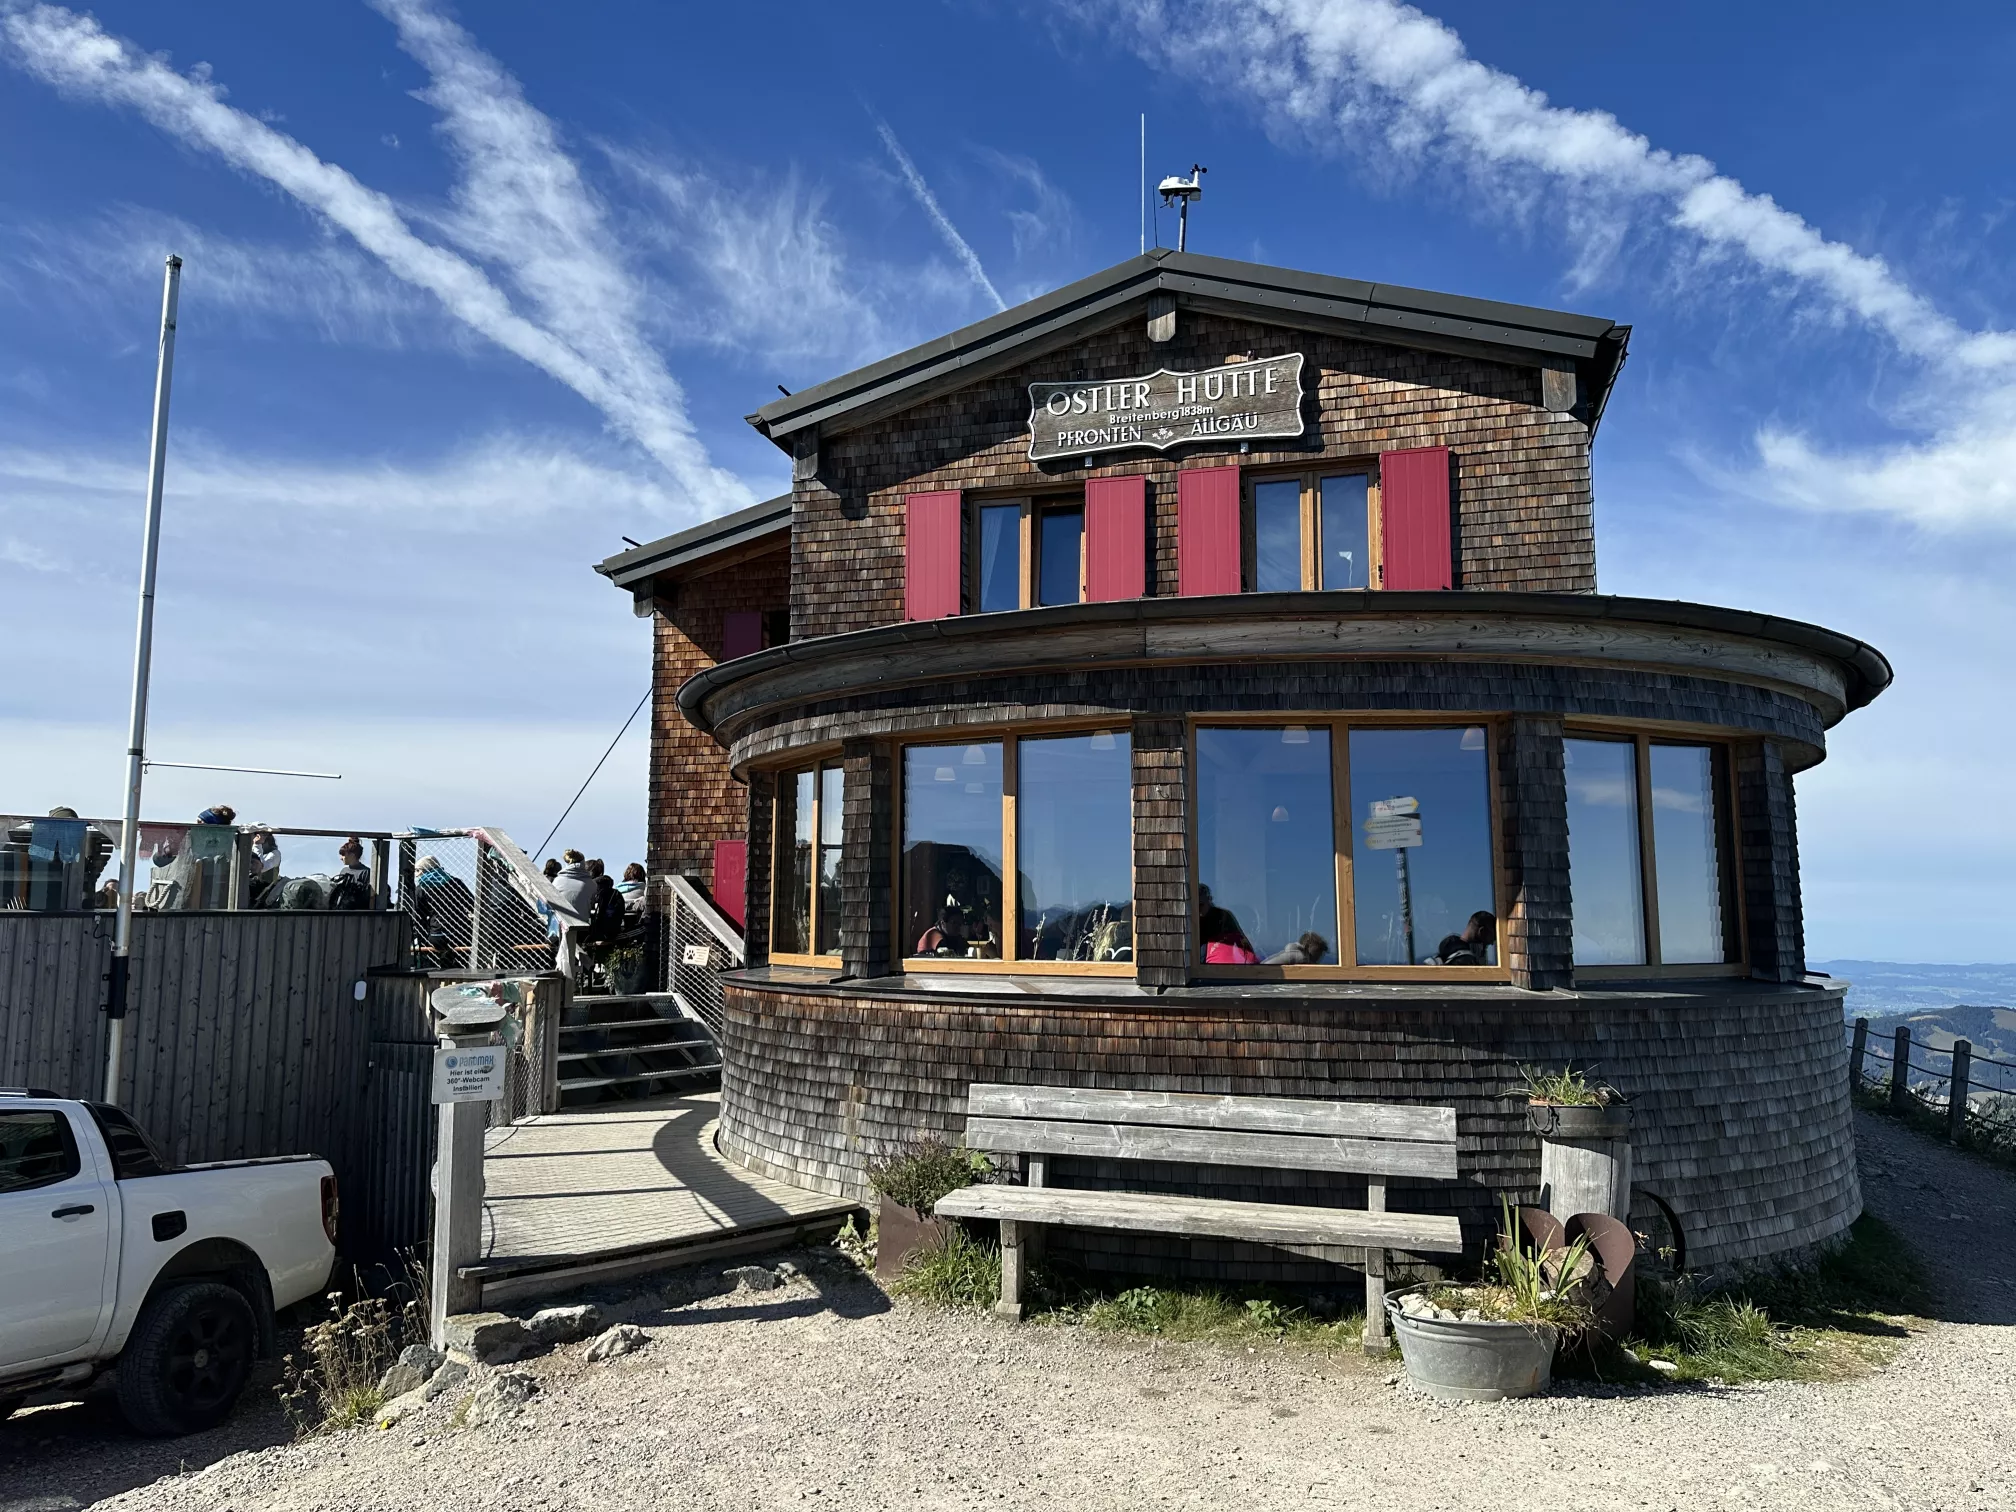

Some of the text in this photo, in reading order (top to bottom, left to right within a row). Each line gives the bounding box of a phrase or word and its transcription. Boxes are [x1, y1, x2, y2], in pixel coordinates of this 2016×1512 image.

[1046, 367, 1278, 416] OSTLER HÜTTE
[1058, 412, 1259, 447] PFRONTEN ALLGÄU
